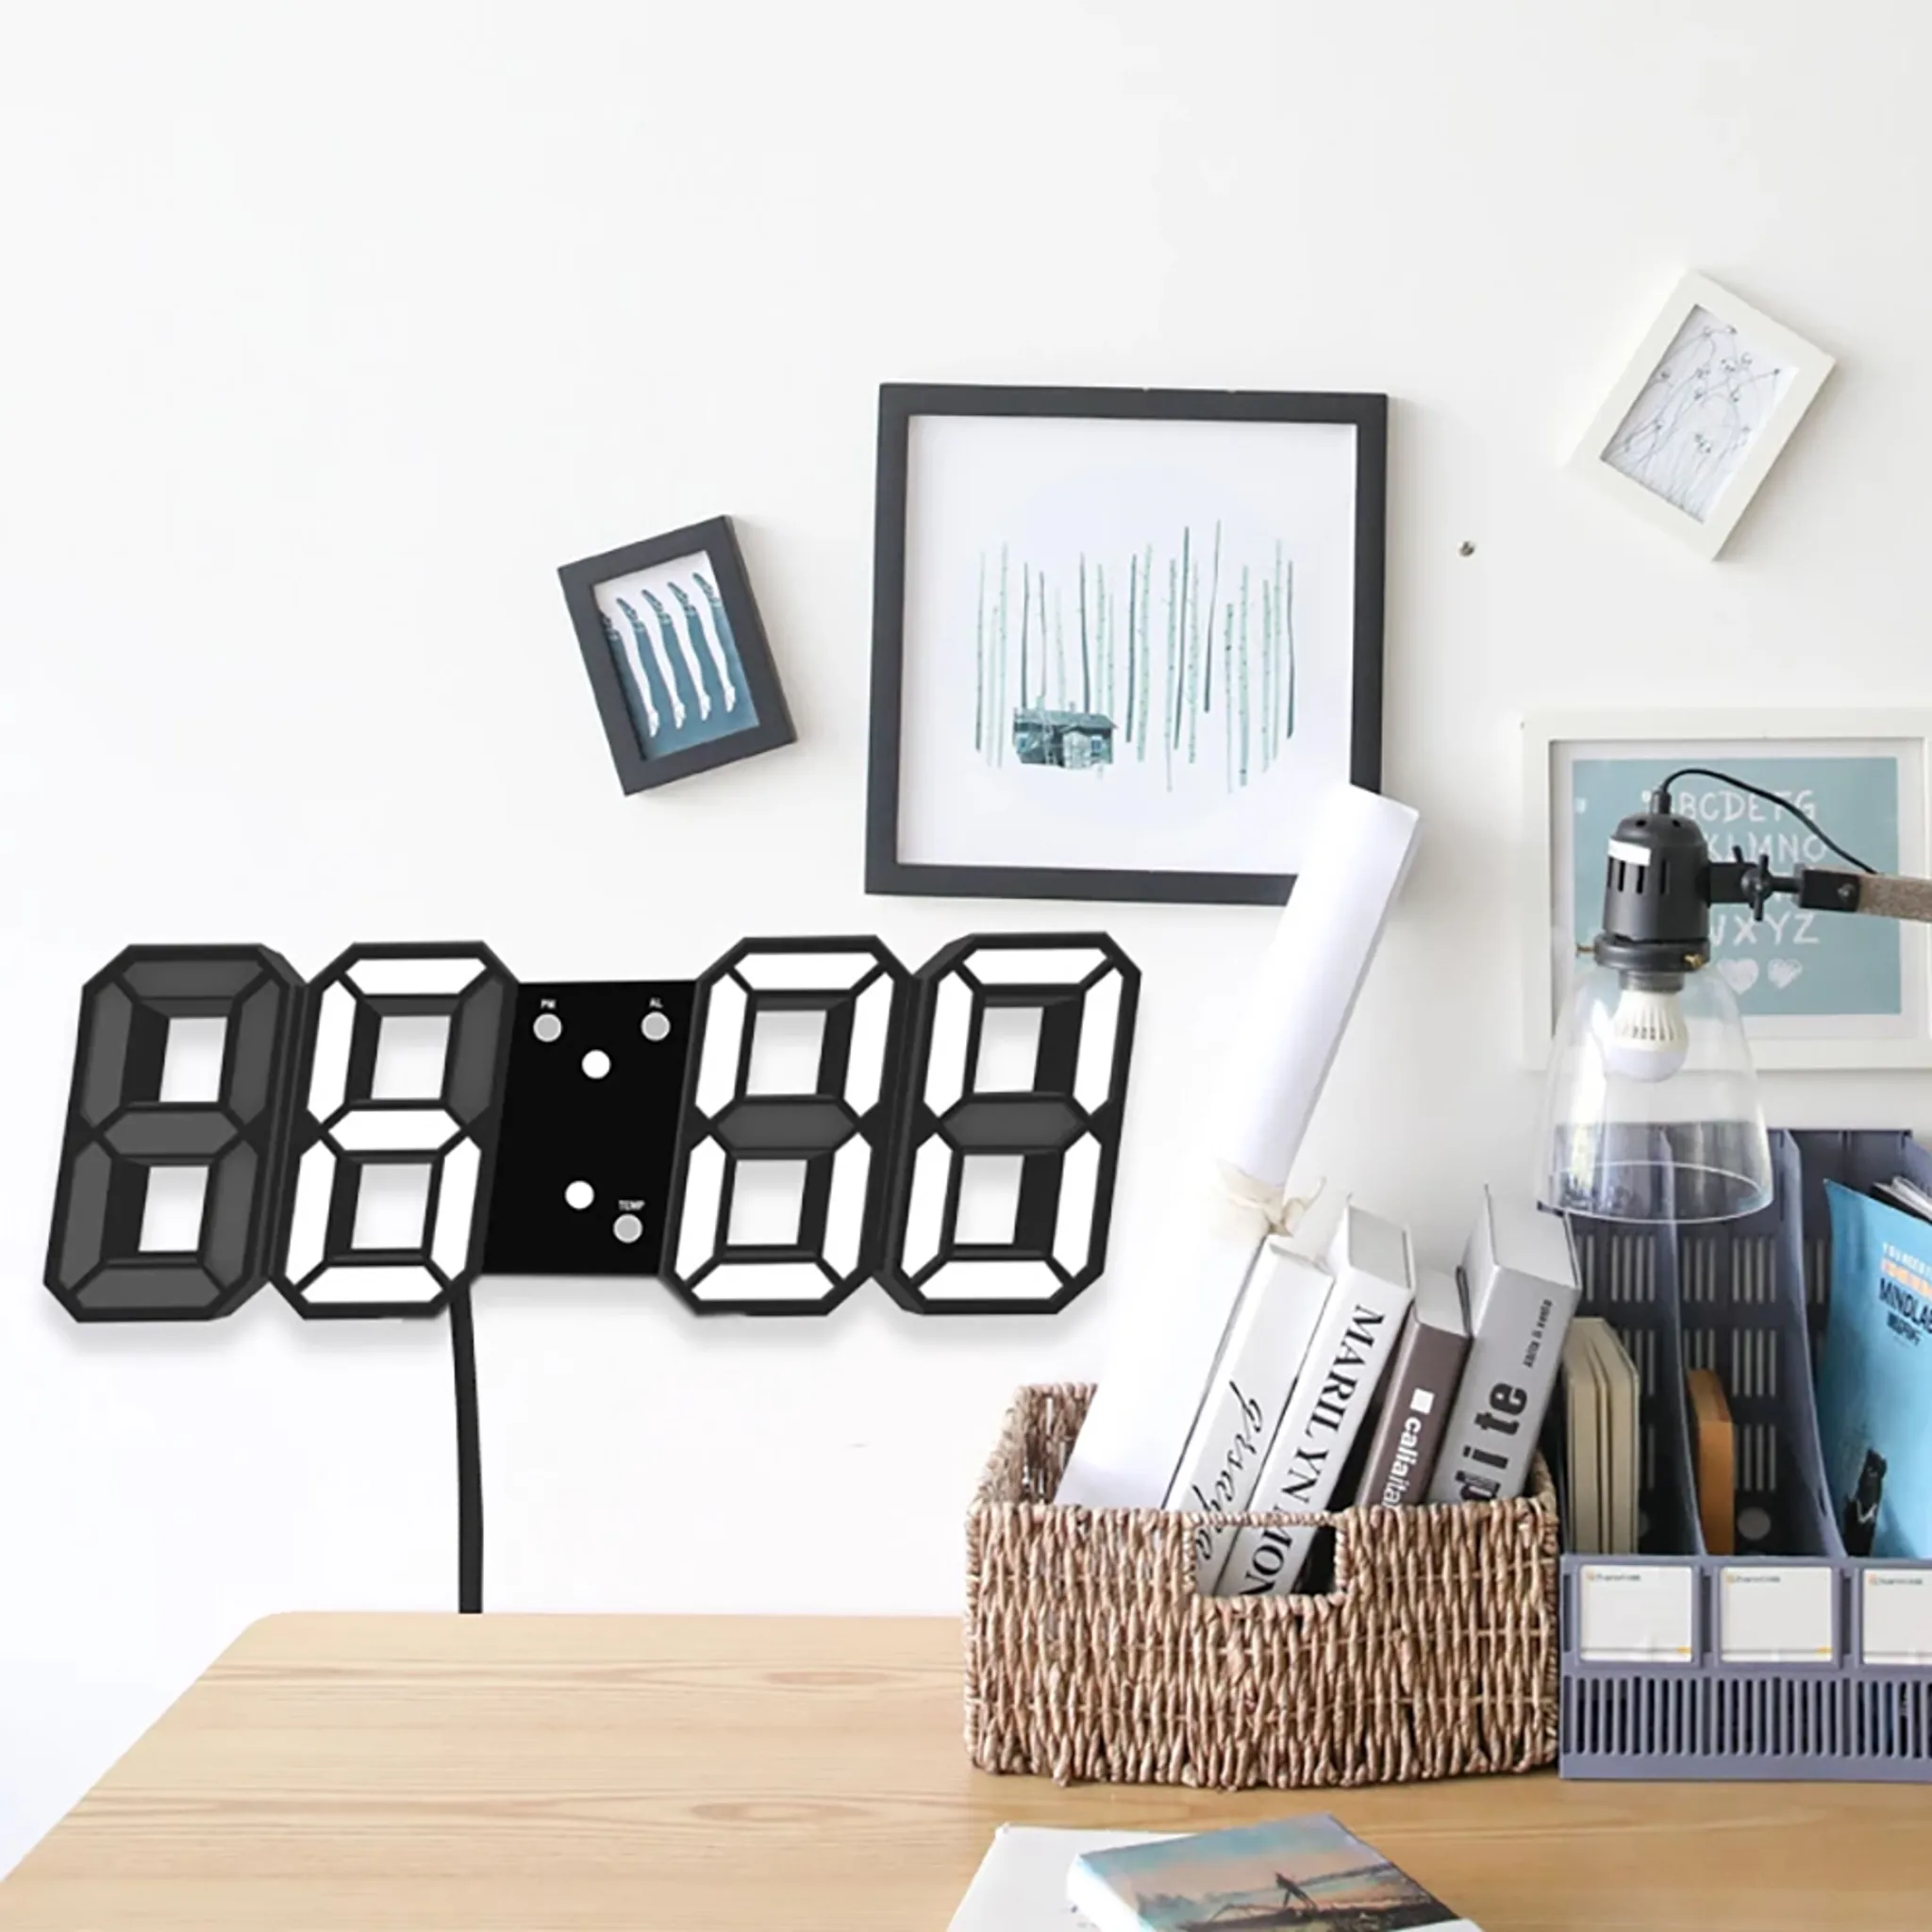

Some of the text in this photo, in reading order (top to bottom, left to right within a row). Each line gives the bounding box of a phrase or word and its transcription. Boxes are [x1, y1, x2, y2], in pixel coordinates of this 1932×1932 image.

[1670, 790, 1817, 823] BCDEFG
[618, 1199, 645, 1211] TEMP
[1280, 1304, 1387, 1505] MARILYN
